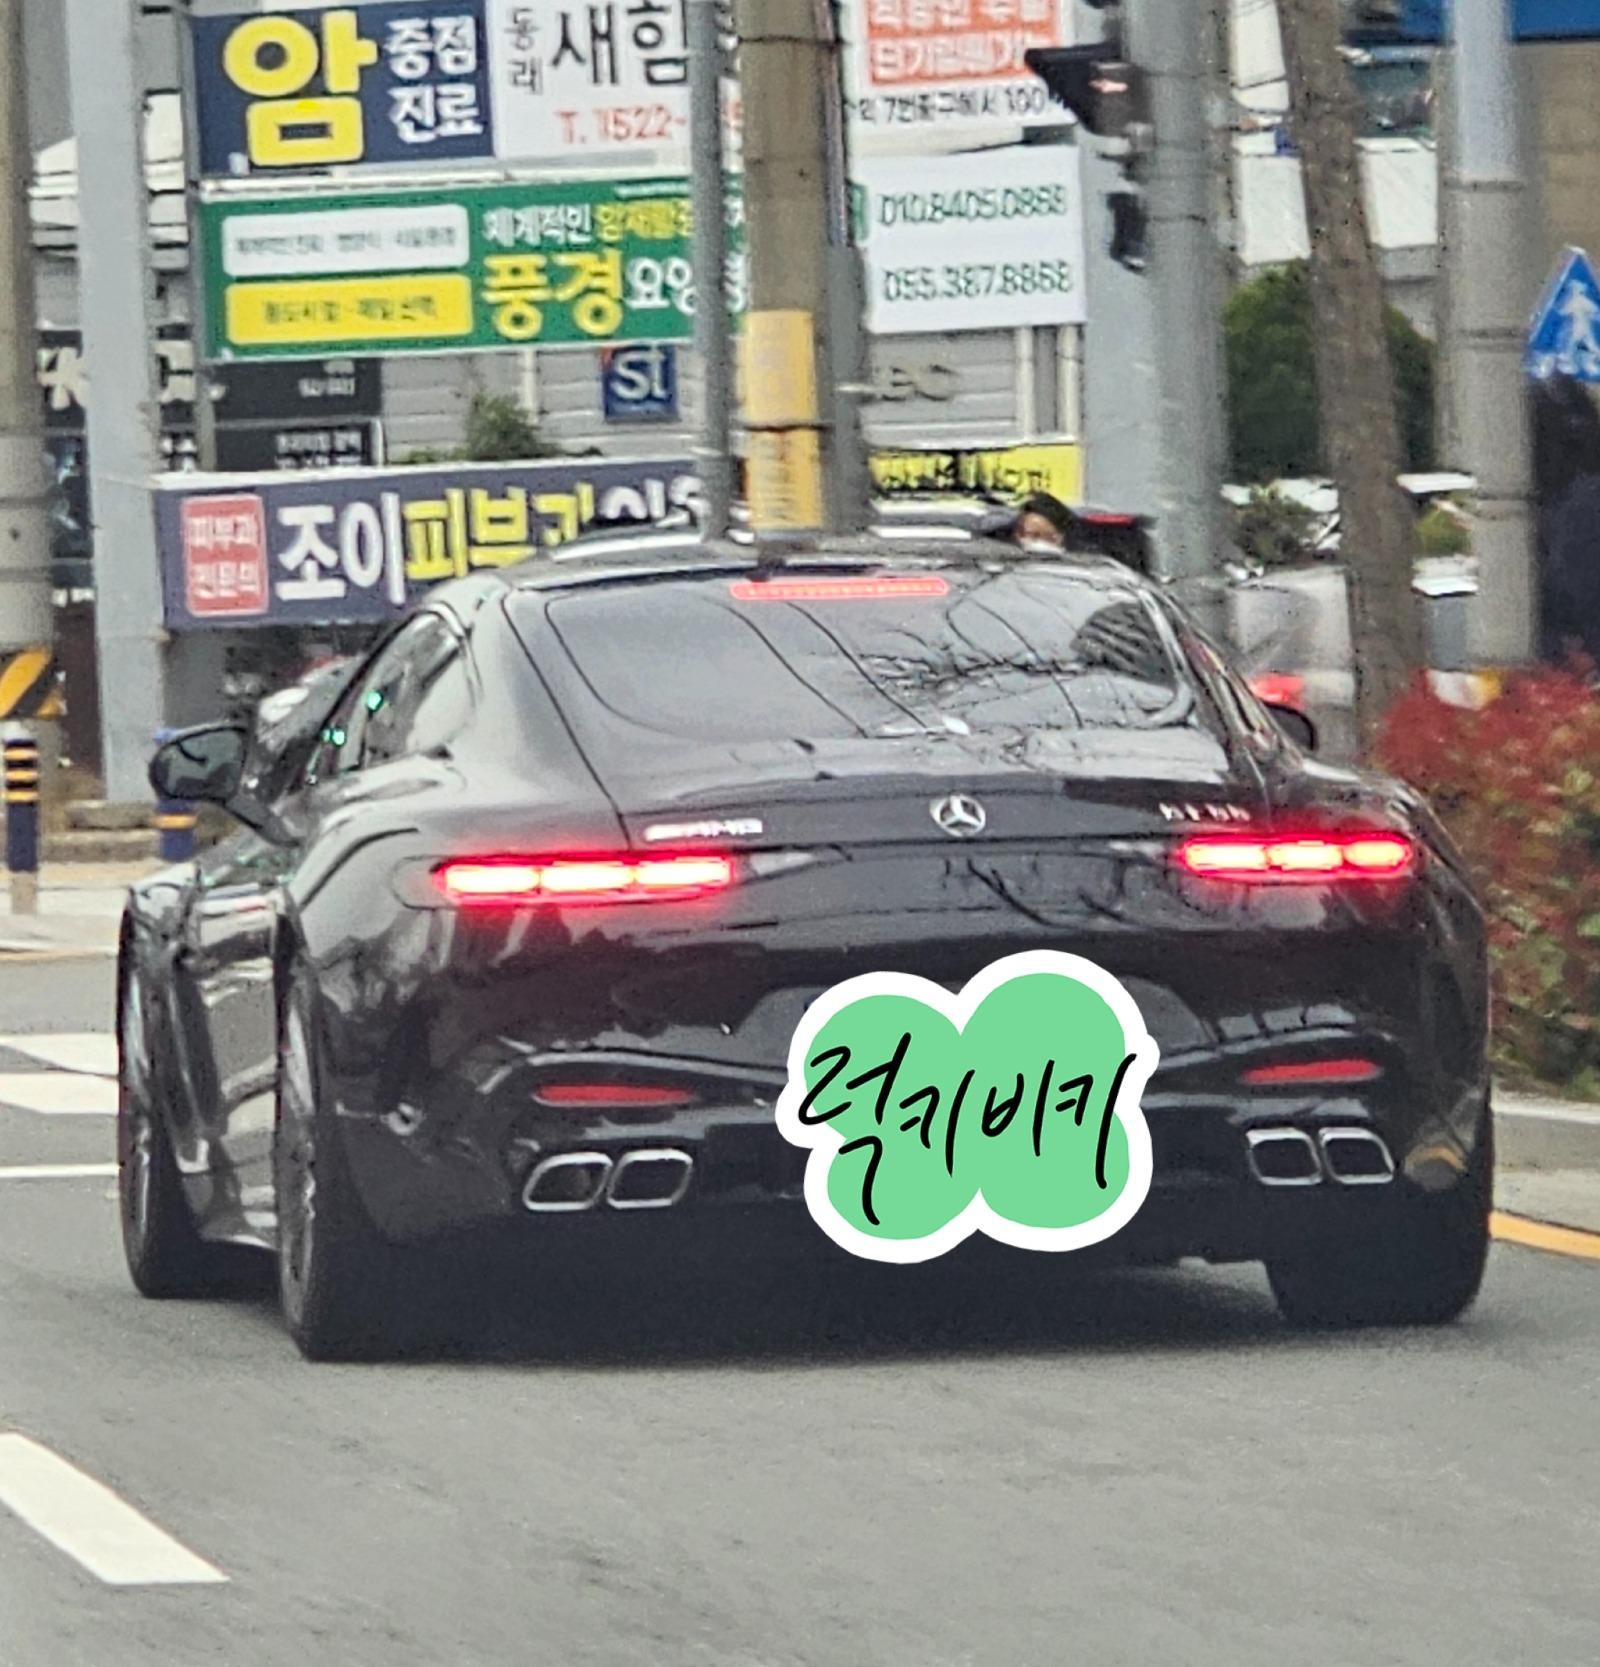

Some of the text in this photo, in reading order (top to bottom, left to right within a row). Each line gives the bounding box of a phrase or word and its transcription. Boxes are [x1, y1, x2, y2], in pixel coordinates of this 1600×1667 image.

[385, 15, 478, 79] 중점
[504, 7, 544, 95] 동래
[222, 9, 379, 167] 암
[388, 83, 485, 144] 진료
